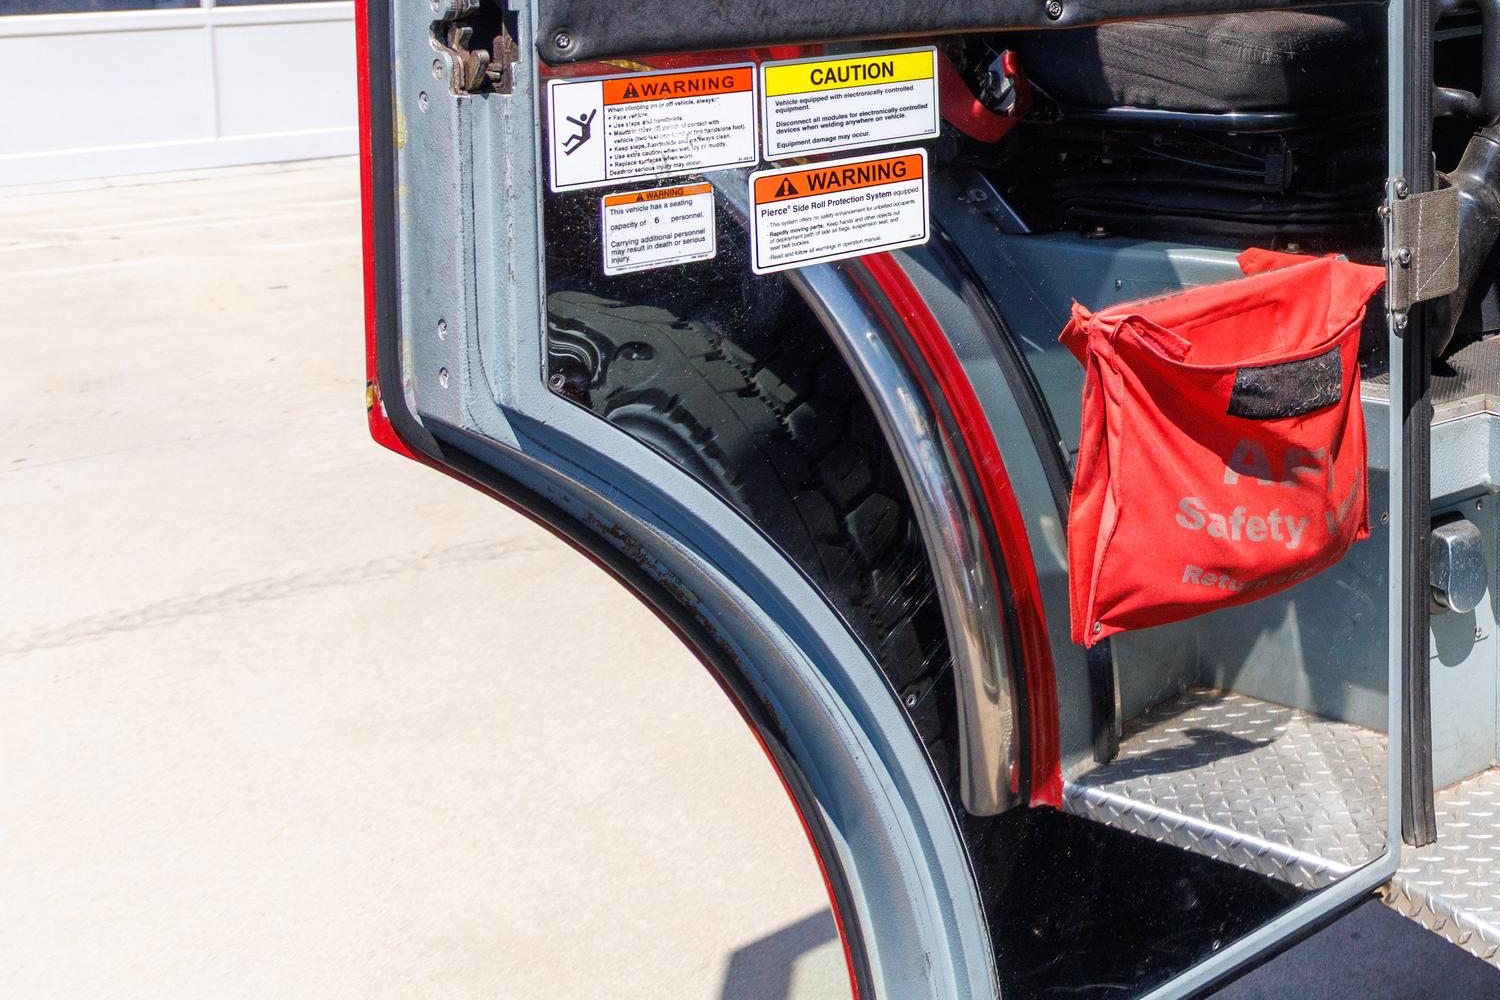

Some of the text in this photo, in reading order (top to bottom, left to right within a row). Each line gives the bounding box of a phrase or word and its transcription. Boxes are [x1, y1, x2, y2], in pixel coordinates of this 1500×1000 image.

[810, 61, 894, 86] CAUTION
[641, 76, 735, 97] WARNING
[799, 96, 828, 104] equipped
[844, 88, 883, 98] electronically
[885, 85, 914, 93] controlled
[625, 104, 649, 112] climbing
[776, 105, 810, 114] equipment.
[776, 118, 811, 127] Disconnect
[822, 113, 848, 121] modules
[859, 107, 898, 116] electronically
[899, 104, 928, 112] controlled
[776, 126, 800, 135] devices
[820, 121, 844, 129] welding
[845, 117, 874, 126] anywhere
[777, 139, 810, 148] Equipment
[812, 136, 836, 144] damage
[806, 161, 906, 191] WARNING
[646, 188, 684, 200] WARNING
[792, 204, 809, 213] Side
[811, 201, 826, 210] Roll
[827, 195, 864, 207] Protection
[866, 190, 892, 202] System
[893, 187, 919, 196] equipped
[625, 205, 649, 213] vehicle
[670, 199, 693, 207] seating
[820, 212, 834, 220] safety
[835, 208, 866, 217] enhancement
[873, 202, 892, 210] unbelted
[610, 222, 638, 231] capacity
[671, 212, 704, 222] personnel.
[611, 228, 705, 248] Carrying additional personnel
[769, 229, 789, 237] Rapidly
[790, 226, 809, 234] moving
[776, 235, 803, 243] deployment
[627, 245, 645, 253] result
[655, 241, 672, 249] death
[683, 236, 705, 244] serious
[816, 244, 836, 252] warnings
[843, 238, 863, 246] operation
[611, 256, 630, 264] injury.
[1175, 496, 1309, 550] Safety
